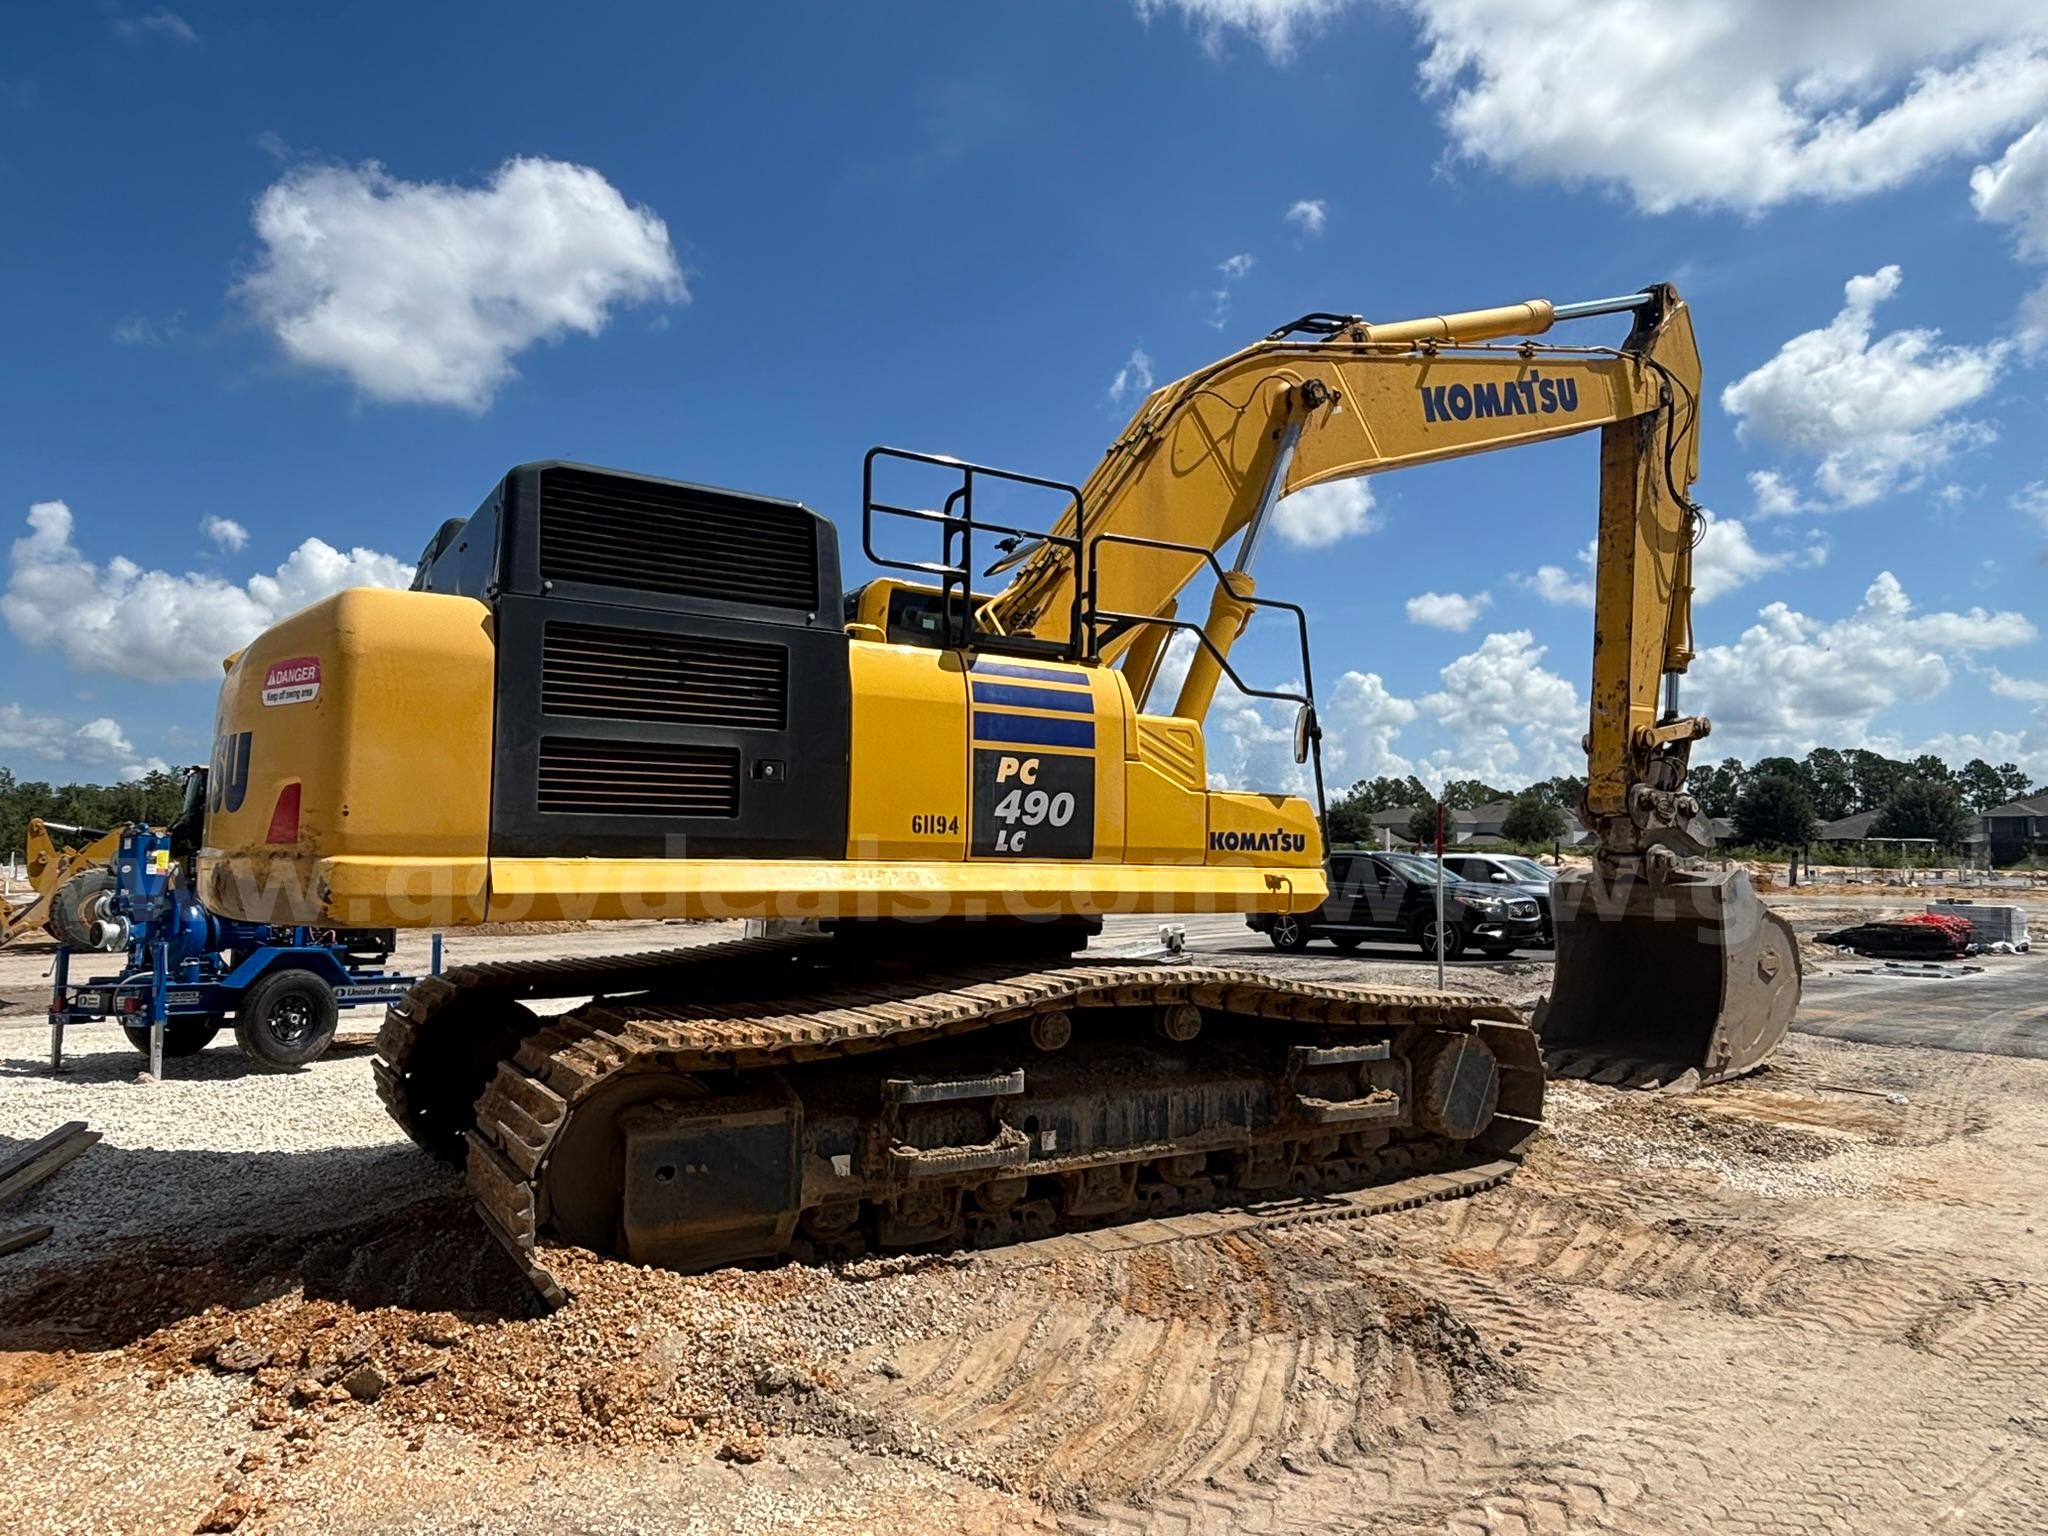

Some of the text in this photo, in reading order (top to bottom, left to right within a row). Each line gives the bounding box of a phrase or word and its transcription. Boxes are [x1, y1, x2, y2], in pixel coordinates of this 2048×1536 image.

[1421, 369, 1579, 423] KOMATSU
[276, 666, 316, 685] DANGER
[996, 756, 1040, 785] PC
[994, 789, 1075, 827] 490
[911, 814, 960, 835] 61194
[994, 830, 1027, 852] LC
[1209, 828, 1305, 852] KOMATSU
